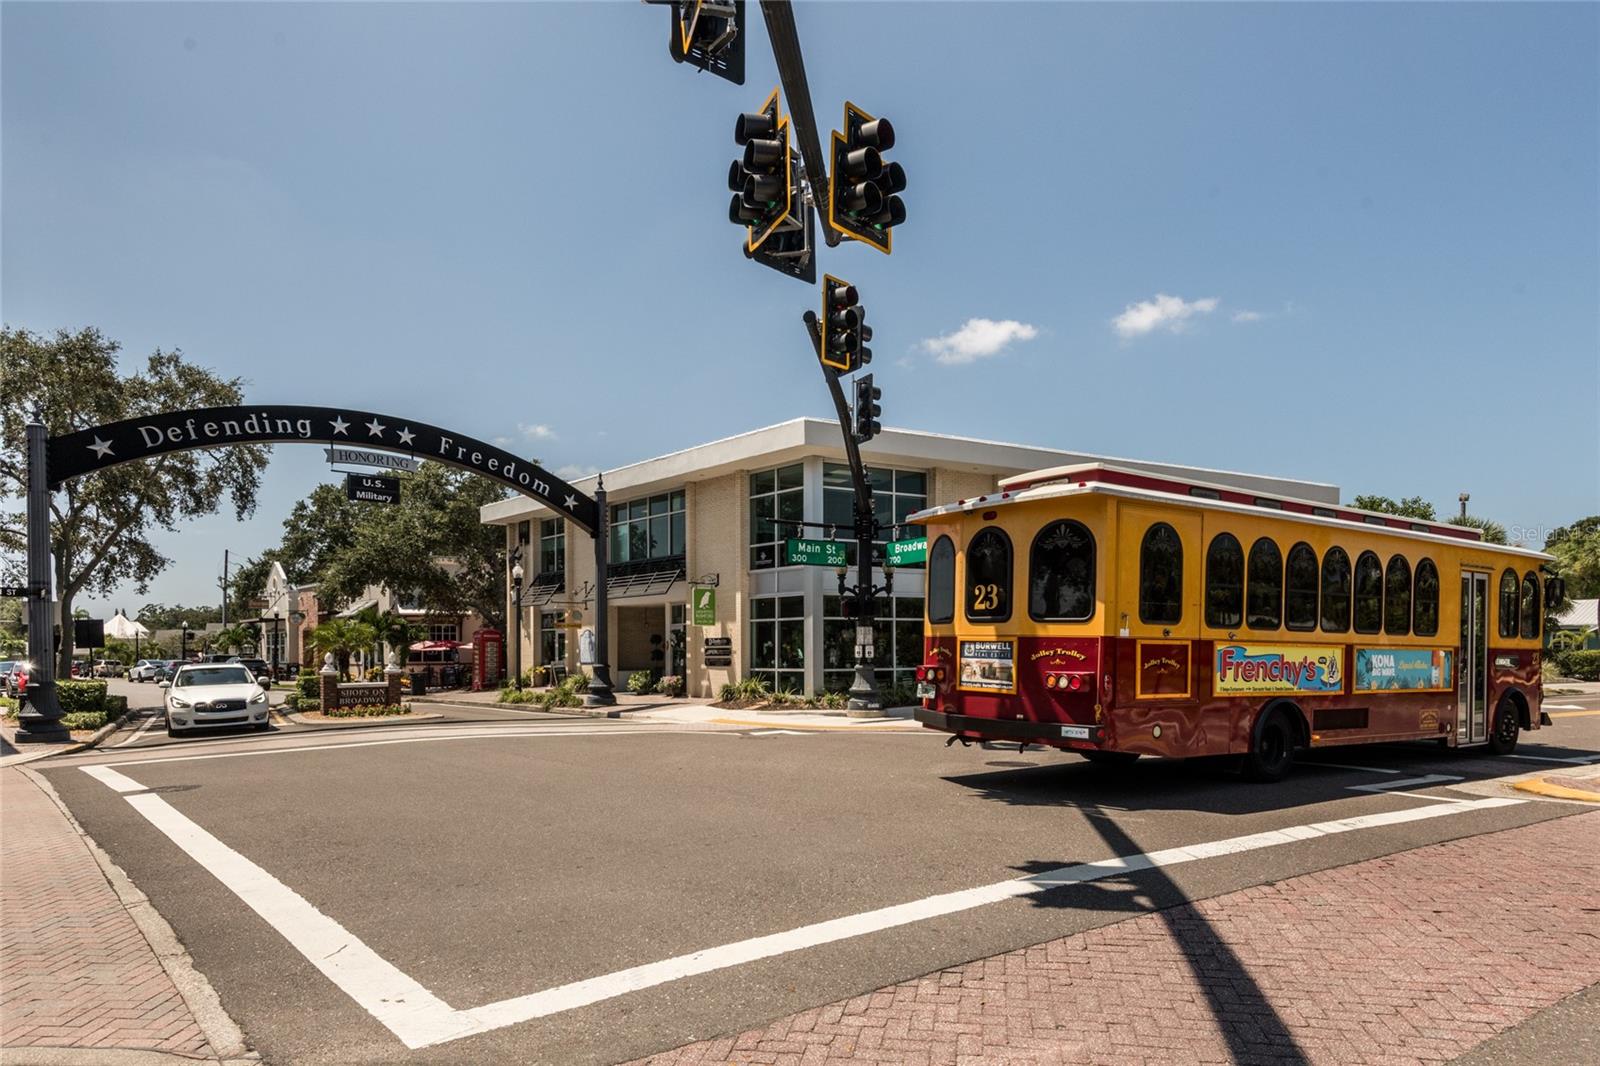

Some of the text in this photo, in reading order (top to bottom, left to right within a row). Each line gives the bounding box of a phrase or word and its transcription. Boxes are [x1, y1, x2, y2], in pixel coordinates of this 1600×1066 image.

[137, 412, 551, 498] Defending Freedom
[338, 450, 409, 469] HONORING
[362, 478, 386, 489] U.S.
[355, 490, 393, 503] Military
[797, 542, 836, 554] Main St
[894, 540, 927, 554] Broadwa
[791, 553, 843, 565] 300 200
[889, 555, 902, 564] 700
[973, 583, 999, 610] 23
[975, 642, 1011, 650] BURWELL
[1055, 647, 1087, 661] Trolley
[1371, 654, 1395, 667] KONA
[1219, 648, 1317, 687] Frenchy's
[340, 688, 385, 697] SHOPS ON
[339, 697, 386, 705] BROADWAY
